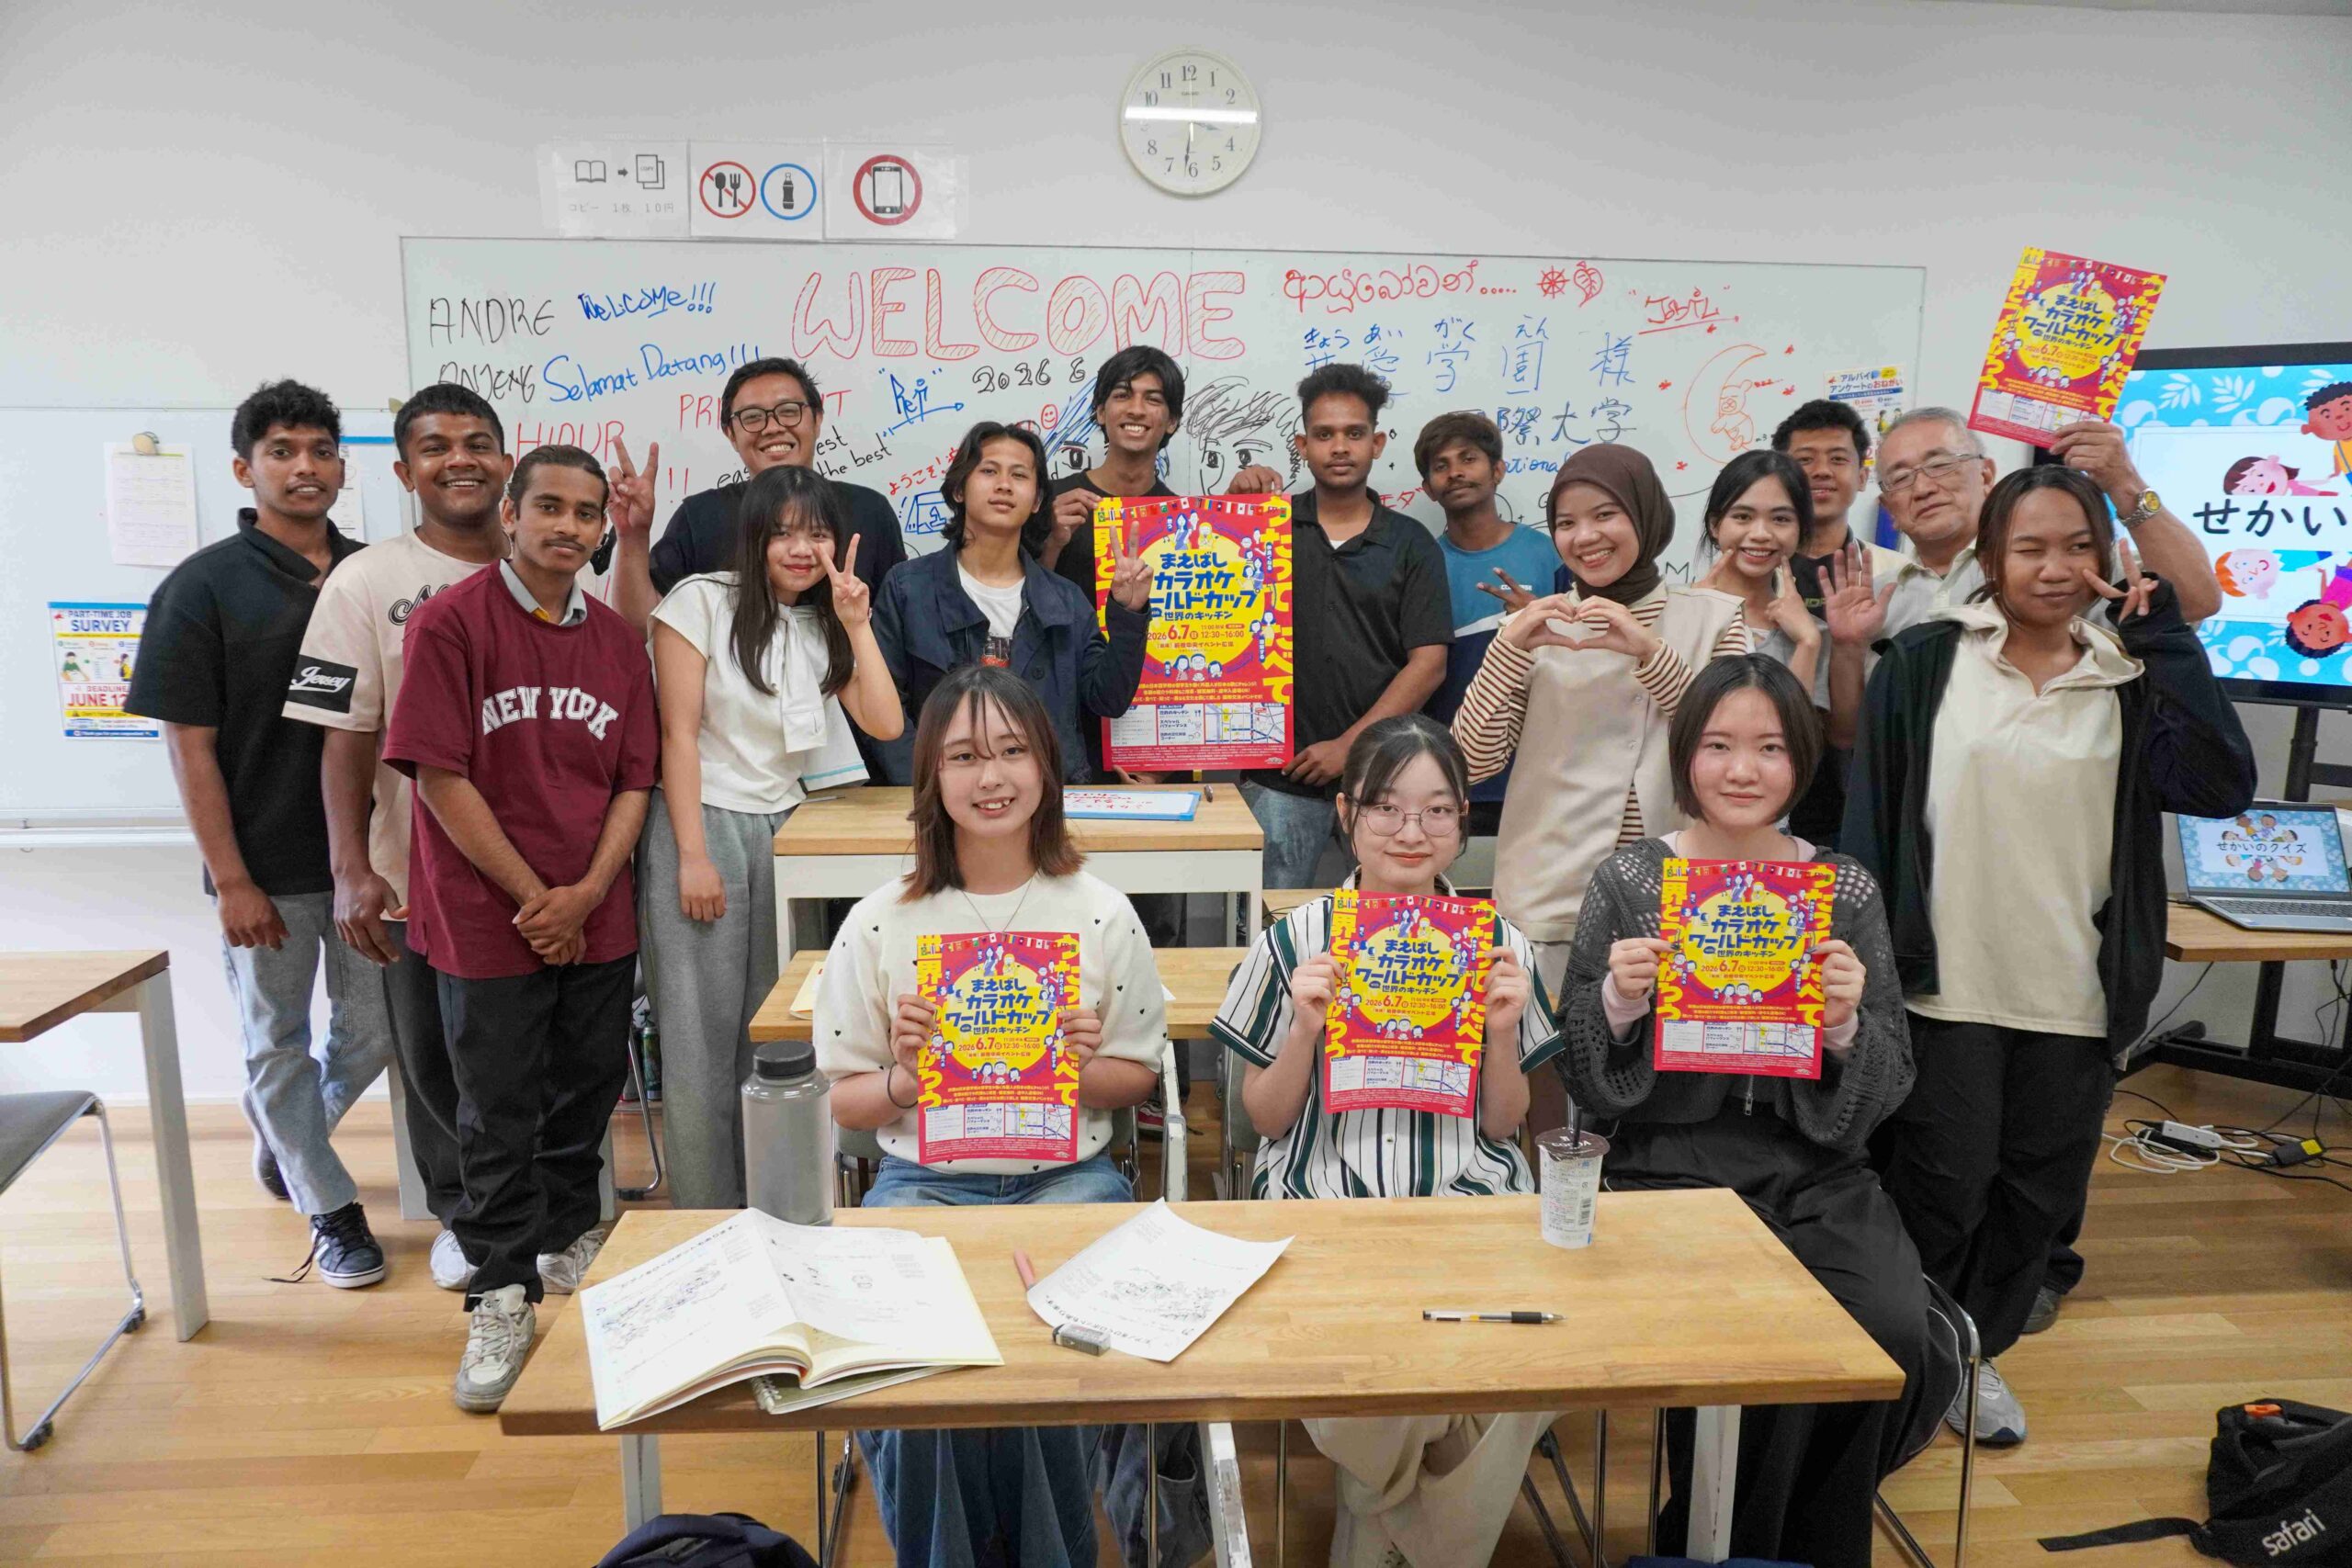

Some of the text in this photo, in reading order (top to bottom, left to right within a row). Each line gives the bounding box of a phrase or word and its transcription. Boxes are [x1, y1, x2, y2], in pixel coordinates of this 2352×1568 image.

[1160, 73, 1171, 88] 11
[1182, 65, 1197, 81] 12
[1210, 71, 1216, 87] 1
[1145, 92, 1159, 107] 10
[1226, 88, 1236, 105] 2
[1148, 140, 1158, 155] 8
[1226, 137, 1234, 152] 4
[1165, 157, 1174, 173] 7
[1188, 162, 1199, 177] 6
[1212, 156, 1221, 171] 5
[569, 202, 600, 213] コピー
[2055, 294, 2103, 314] まえばし
[792, 266, 1247, 360] WELCOME
[2045, 306, 2105, 329] カラオケ
[429, 298, 555, 347] ANDRE
[2023, 315, 2118, 346] ワールドカップ
[1305, 315, 1550, 349] きょう あい がく えん
[2041, 344, 2060, 356] 6.7
[542, 355, 639, 402] Selamat
[972, 358, 1051, 394] 2026
[1840, 371, 1873, 383] アルバイ
[1449, 396, 1638, 446] 際大学
[816, 425, 848, 456] est
[2192, 497, 2347, 537] せかい
[1159, 551, 1228, 570] まえばし
[1154, 570, 1235, 591] カラオケ
[1149, 588, 1260, 610] ールドカップ
[68, 610, 115, 618] PART-TIME
[1164, 611, 1233, 622] 世界のキッチン
[71, 619, 130, 632] SURVEY
[1168, 625, 1191, 640] 6.7
[288, 666, 352, 694] Jersey
[68, 694, 107, 706] JUNE
[482, 685, 619, 740] NEW YORK
[2215, 841, 2308, 854] せかいのクイズ
[1717, 904, 1775, 918] まえばし
[1711, 919, 1781, 933] カラオケ
[1385, 939, 1441, 954] まえばし
[1689, 934, 1802, 950] ワールドカップ
[1716, 949, 1776, 957] 世界のキッチン
[1377, 954, 1444, 971] カラオケ
[1719, 960, 1739, 973] 6.7
[971, 976, 1027, 992] まえばし
[1355, 967, 1463, 987] ワールドカップ
[1382, 985, 1440, 994] 世界のキッチン
[966, 993, 1033, 1010] カラオケ
[1365, 998, 1383, 1007] 2026
[1383, 994, 1403, 1008] 6.7
[945, 1010, 1054, 1027] ワールドカップ
[973, 1026, 1031, 1035] 世界のキッチン
[976, 1037, 995, 1050] 6.7
[2261, 1507, 2326, 1557] safari
